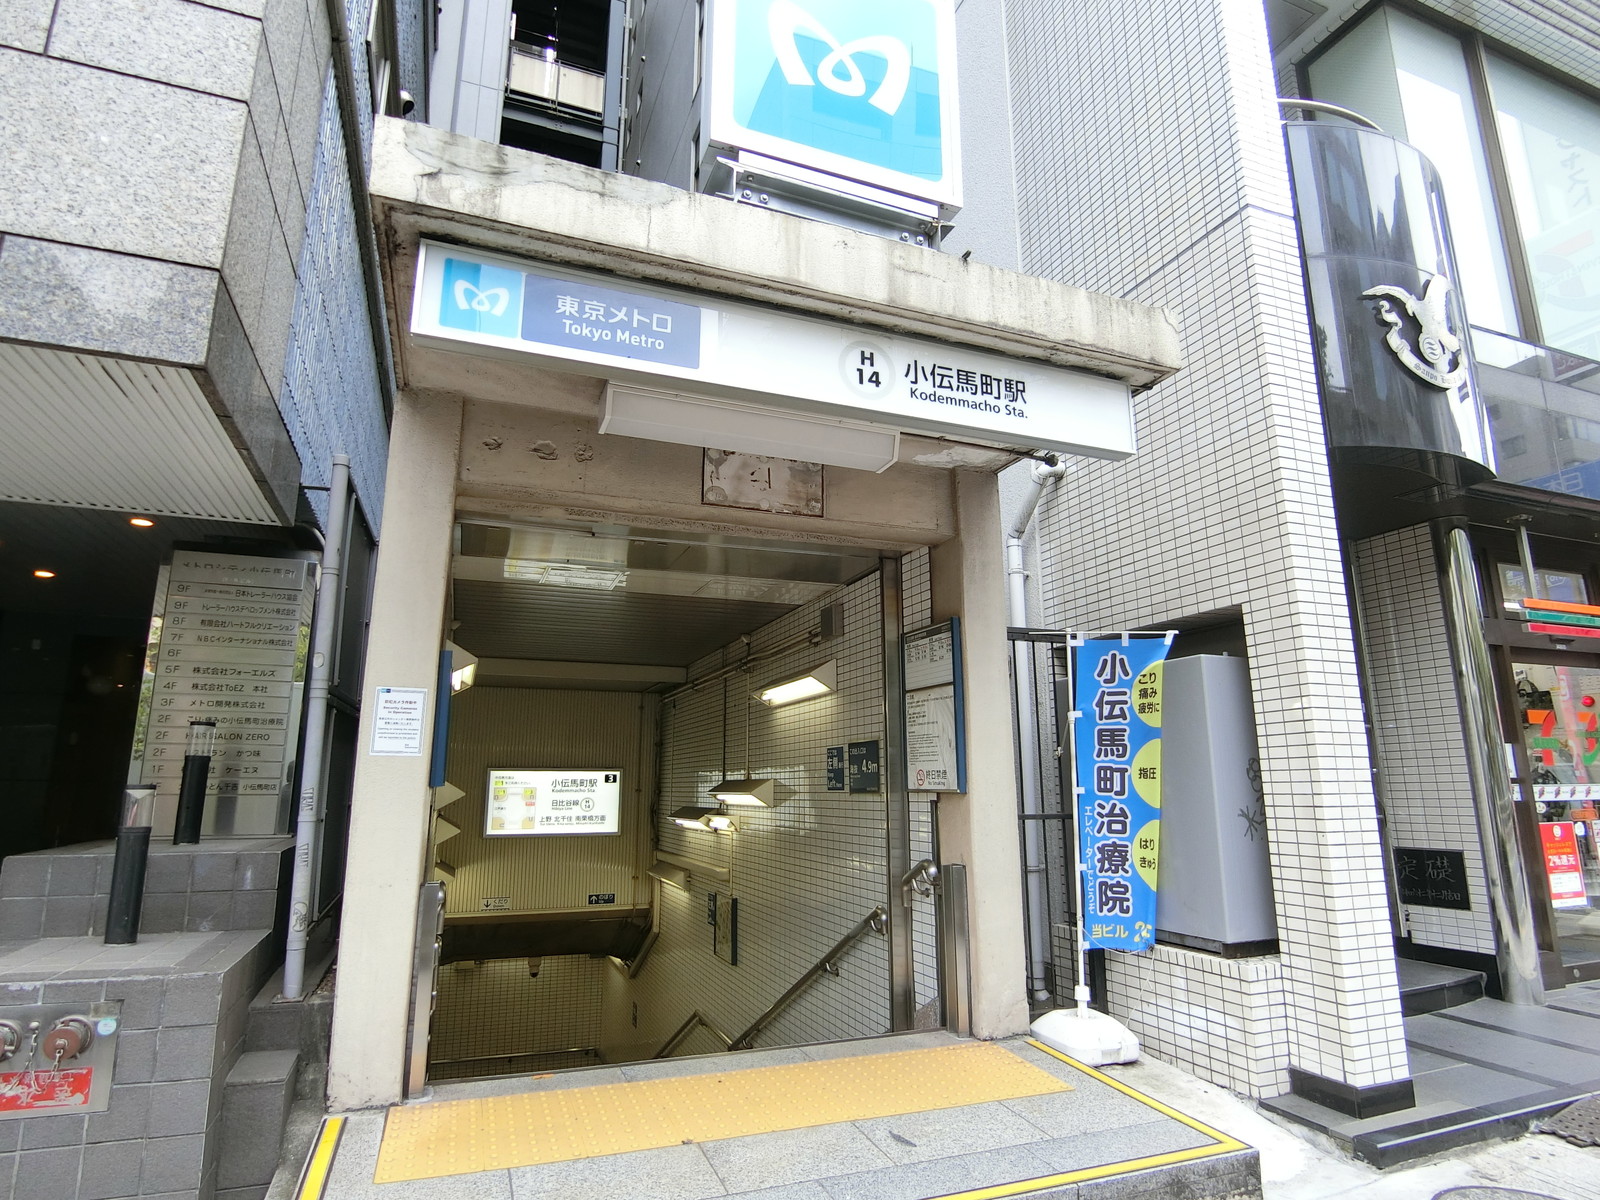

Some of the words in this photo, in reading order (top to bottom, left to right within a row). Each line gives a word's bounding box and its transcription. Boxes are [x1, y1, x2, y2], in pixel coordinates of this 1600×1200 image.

[555, 294, 673, 334] 東京メトロ
[562, 320, 612, 341] Tokyo
[616, 329, 665, 350] Metro
[860, 350, 875, 367] H
[856, 368, 881, 388] 14
[904, 360, 1027, 404] 小伝馬町駅
[910, 387, 1001, 414] Kodemmacho
[1005, 403, 1028, 419] Sta.
[177, 584, 191, 593] 9F
[174, 601, 189, 610] 9F
[172, 617, 187, 625] 8F
[170, 633, 184, 641] 7F
[167, 649, 182, 657] 6F
[165, 665, 180, 673] 5F
[192, 667, 276, 677] 株式会社フォーエルズ
[1138, 672, 1157, 684] こり
[163, 682, 178, 690] 4F
[252, 685, 268, 693] 本社
[1138, 687, 1158, 700] 痛み
[160, 698, 175, 706] 3F
[190, 700, 265, 709] メトロ開発株式会社
[1138, 702, 1160, 714] 疲労に
[157, 715, 172, 723] 2F
[155, 731, 169, 739] 2F
[245, 733, 270, 741] ZERO
[153, 748, 167, 756] 2F
[152, 765, 164, 773] 1F
[225, 766, 259, 774] ケーエヌ
[861, 758, 878, 774] 4.9m
[925, 769, 948, 780] 終日禁煙
[1138, 767, 1157, 780] 指圧
[551, 778, 598, 788] 小伝馬町駅
[1095, 651, 1131, 916] 小伝馬町治療院
[551, 799, 580, 807] 日比谷線
[539, 815, 552, 823] 上野
[1139, 838, 1155, 851] はり
[1139, 857, 1157, 870] きゅう
[1092, 923, 1129, 939] 当ビル
